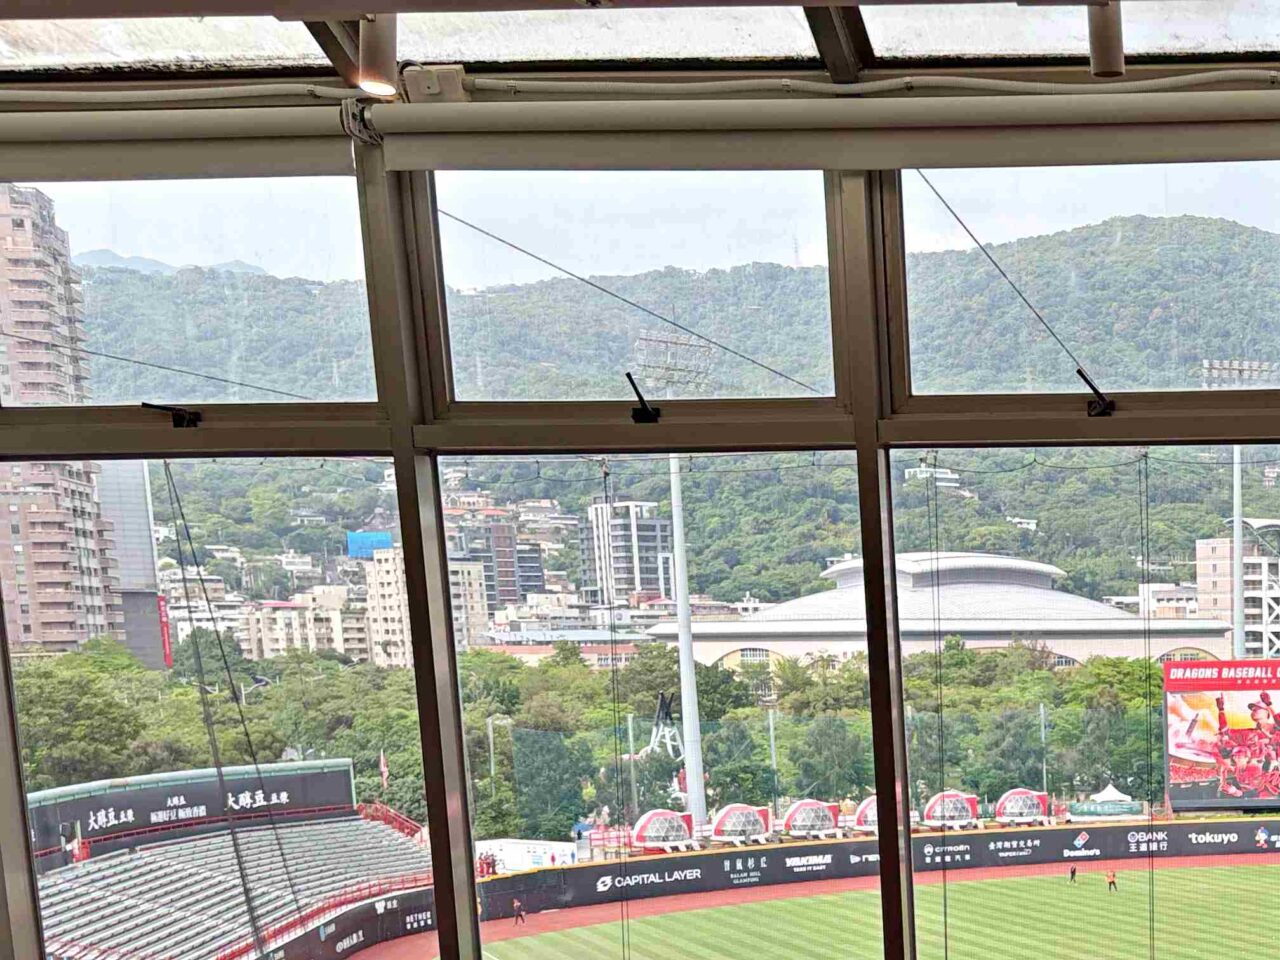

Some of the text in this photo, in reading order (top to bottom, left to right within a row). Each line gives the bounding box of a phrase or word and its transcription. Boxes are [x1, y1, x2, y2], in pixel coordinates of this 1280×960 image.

[1169, 667, 1219, 680] DRAGONS
[1221, 667, 1273, 679] BASEBALL
[1190, 832, 1239, 845] tokuyo
[1062, 848, 1101, 858] Domino's
[785, 854, 834, 868] YAKIMA
[614, 868, 702, 888] CAPITAL LAYER
